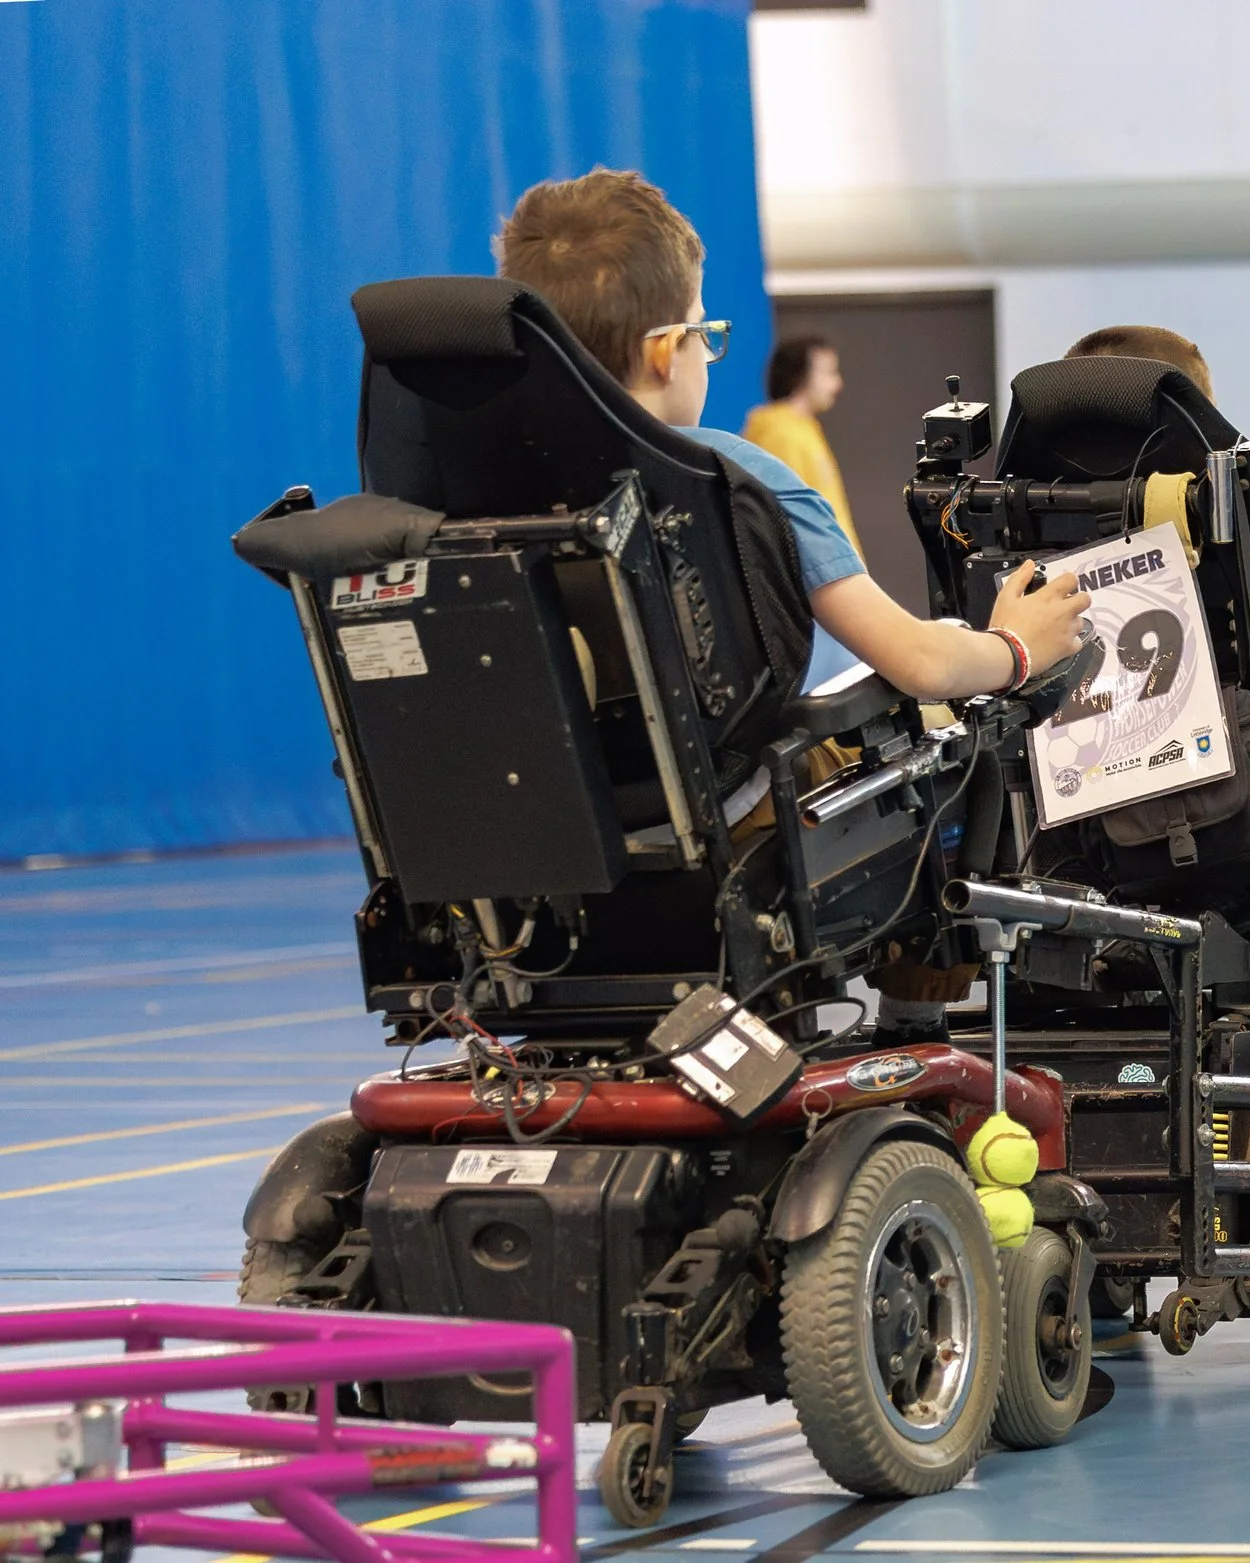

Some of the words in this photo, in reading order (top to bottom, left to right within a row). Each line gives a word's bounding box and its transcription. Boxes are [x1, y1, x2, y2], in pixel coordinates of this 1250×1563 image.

[1074, 549, 1166, 593] NEKER
[336, 584, 416, 605] BLISS
[1107, 732, 1147, 763] SOCCER
[1147, 713, 1172, 743] CLUB
[1105, 756, 1142, 772] MOTION
[1148, 746, 1184, 768] ACPSA
